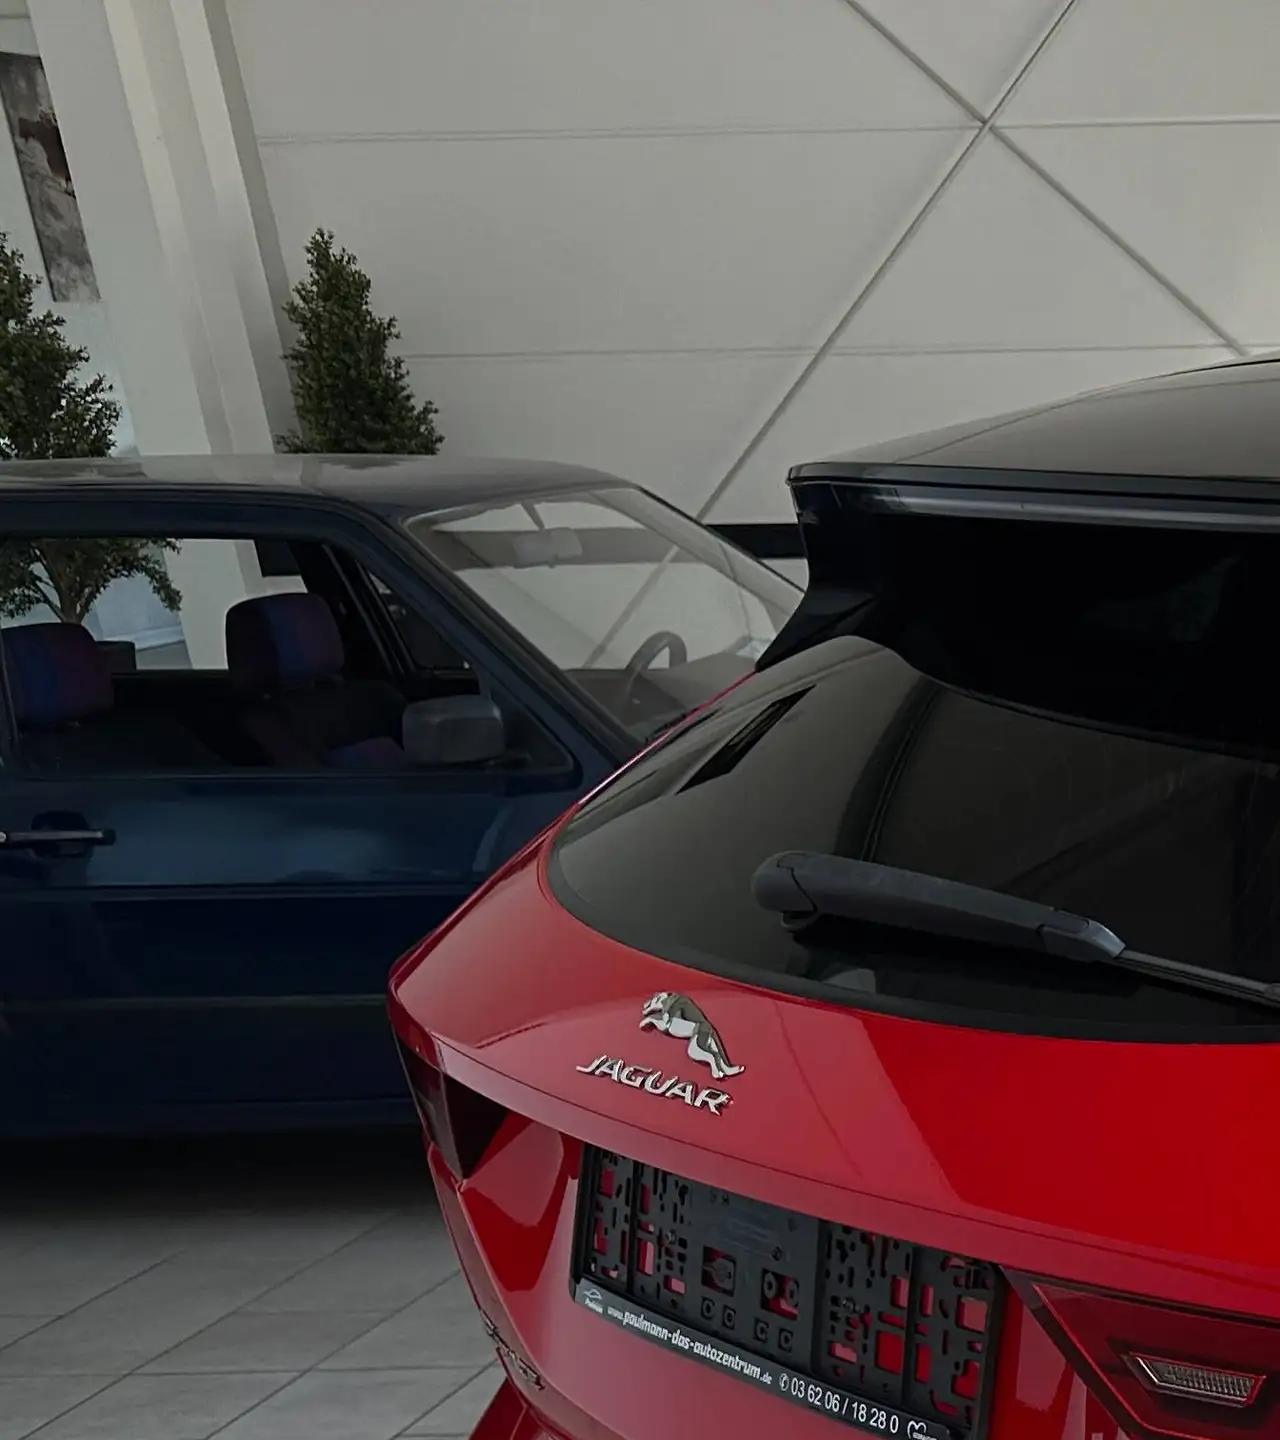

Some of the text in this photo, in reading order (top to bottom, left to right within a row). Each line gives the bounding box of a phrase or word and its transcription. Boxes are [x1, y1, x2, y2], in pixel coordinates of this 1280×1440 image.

[576, 1055, 731, 1116] JAGUAR
[607, 1305, 772, 1385] www.paulmann-das-autozentrum.de
[791, 1377, 805, 1398] 03
[808, 1384, 822, 1406] 62
[825, 1391, 840, 1412] 06
[852, 1402, 867, 1422] 18
[870, 1408, 886, 1429] 28
[890, 1415, 899, 1433] 0
